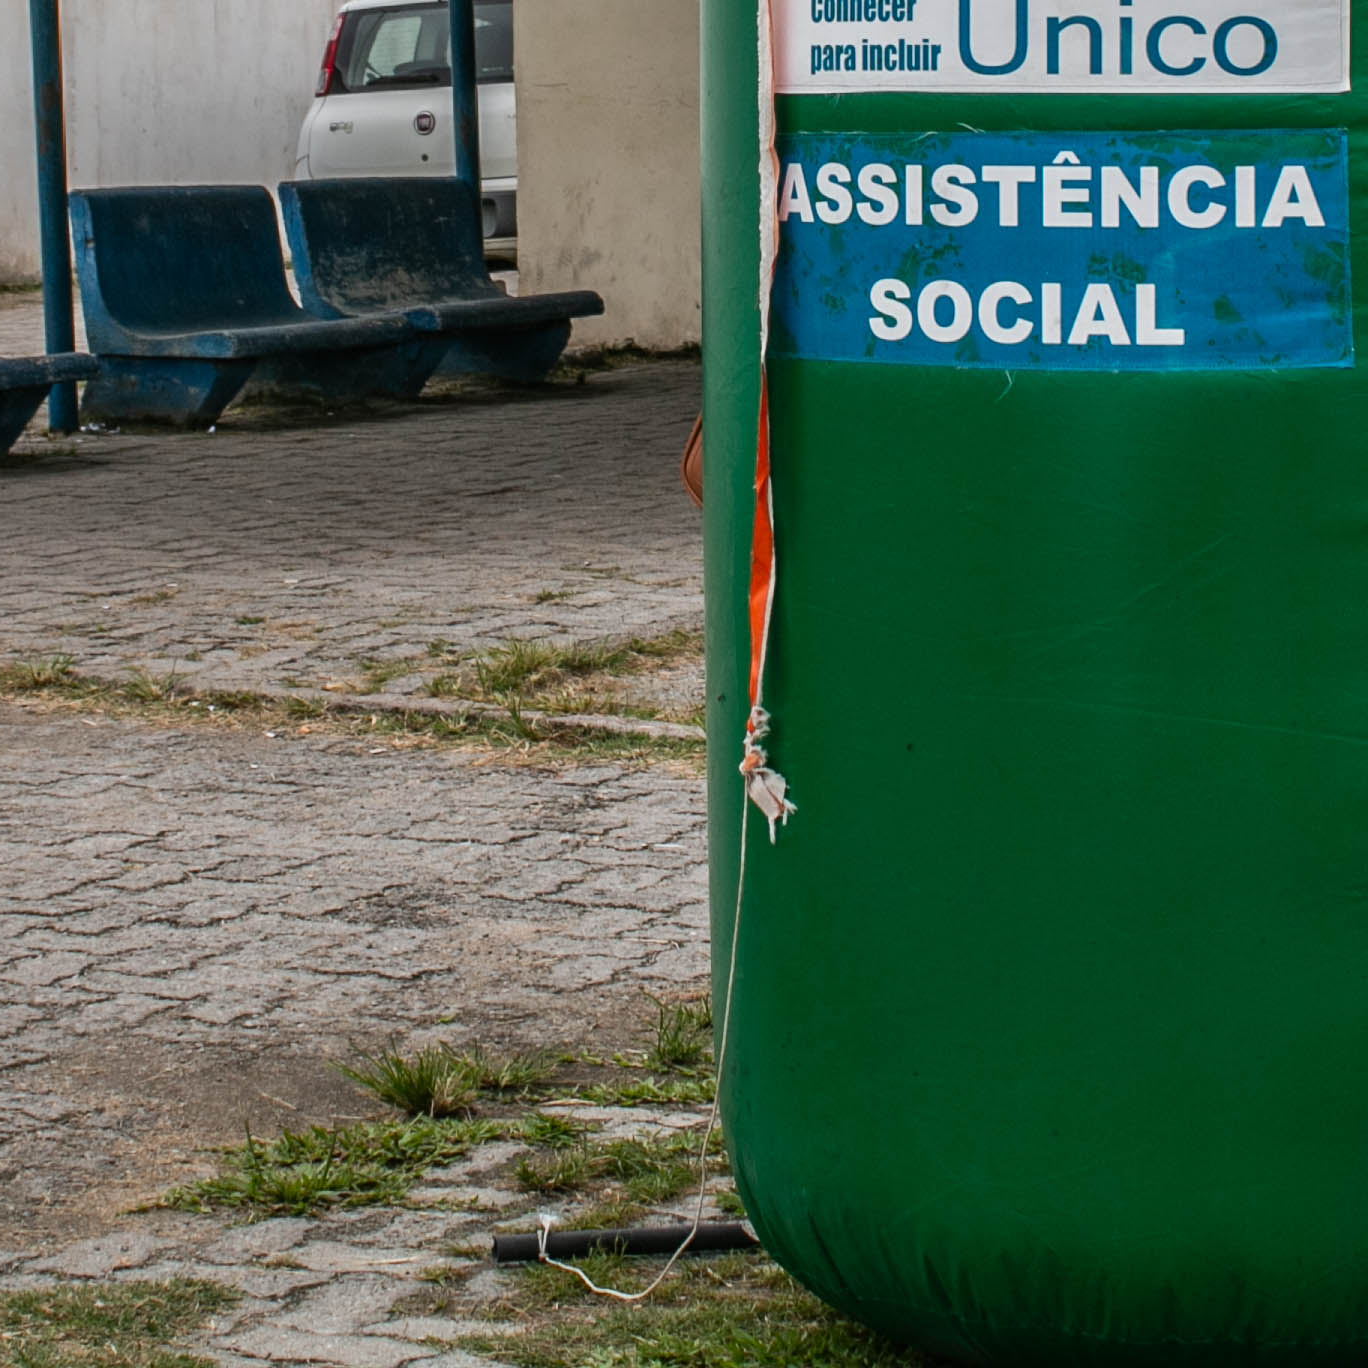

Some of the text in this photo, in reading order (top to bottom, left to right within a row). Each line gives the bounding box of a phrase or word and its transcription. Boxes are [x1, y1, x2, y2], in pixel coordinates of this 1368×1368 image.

[810, 38, 942, 75] para incluir
[779, 151, 1325, 228] ASSISTÊNCIA
[869, 279, 1185, 345] SOCIAL
